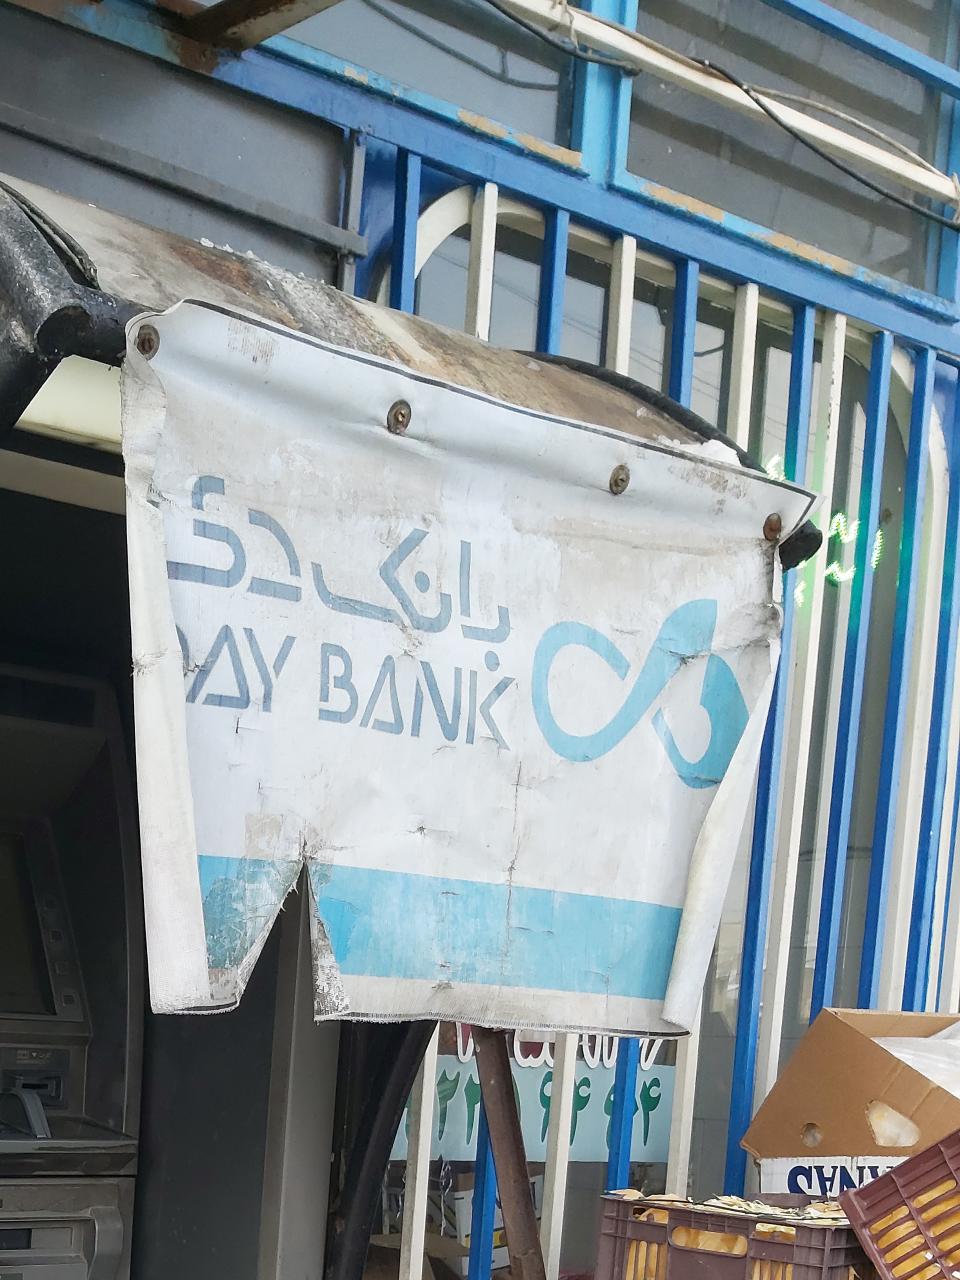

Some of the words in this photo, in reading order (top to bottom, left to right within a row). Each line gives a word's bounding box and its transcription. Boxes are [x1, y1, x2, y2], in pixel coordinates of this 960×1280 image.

[312, 528, 510, 673] بانک
[175, 624, 296, 713] AY
[317, 641, 517, 750] BANK
